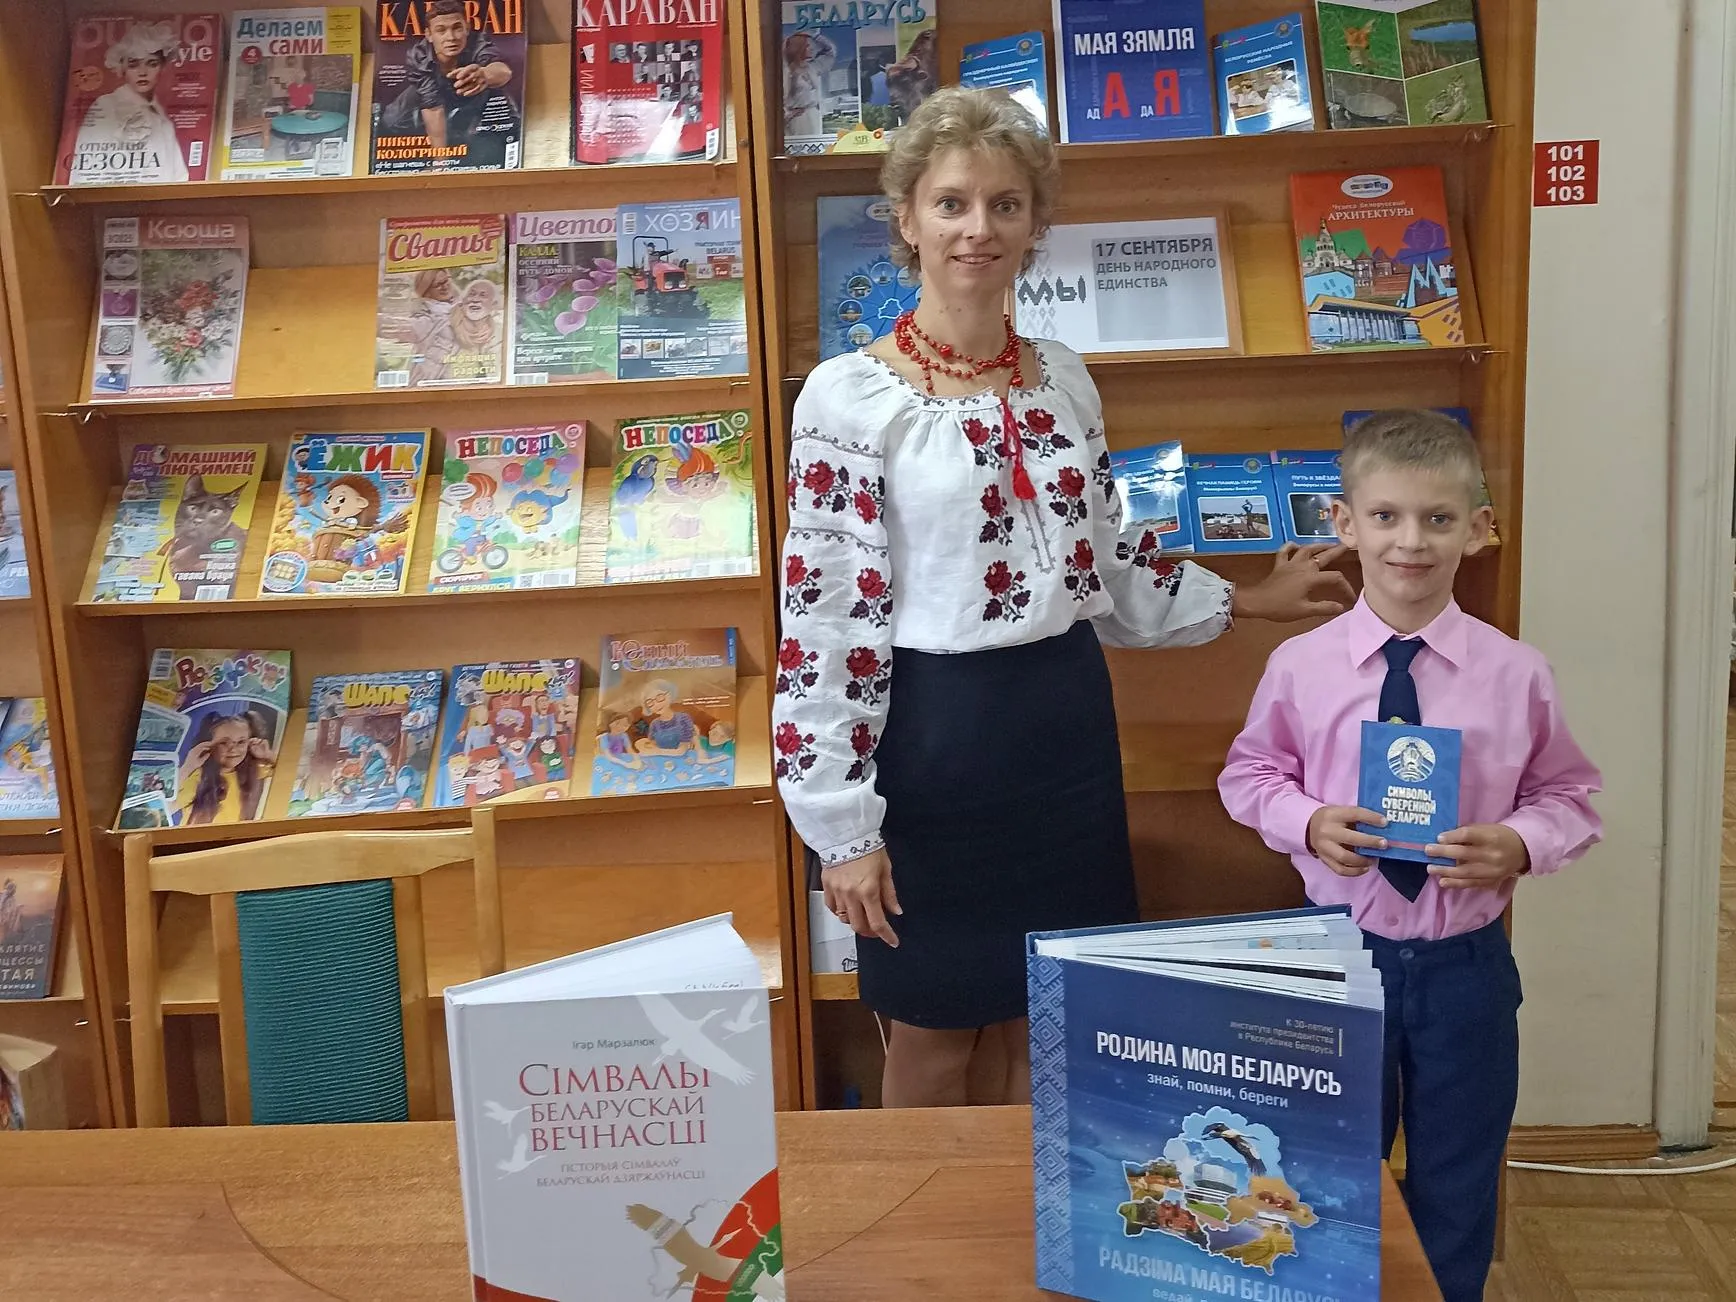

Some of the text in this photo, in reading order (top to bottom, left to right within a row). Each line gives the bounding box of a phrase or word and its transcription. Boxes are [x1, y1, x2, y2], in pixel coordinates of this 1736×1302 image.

[380, 0, 524, 36] КАВАН
[237, 19, 323, 38] Делаем
[269, 38, 323, 55] сами
[1074, 28, 1195, 56] МАЯ ЗЯМЛЯ
[1086, 69, 1181, 120] АД А ДА Я
[63, 151, 161, 171] СЕЗОНА
[376, 144, 467, 160] КОЛОГРИВЫЙ
[1547, 144, 1584, 162] 101
[1547, 165, 1585, 181] 102
[1547, 186, 1585, 202] 103
[1328, 208, 1414, 221] АРХИТЕКТУРЫ
[148, 220, 235, 240] Ксюша
[388, 233, 493, 262] Сваты
[1096, 238, 1213, 258] 17 СЕНТЯБРЯ
[1096, 258, 1216, 275] ДЕНЬ НАРОДНОГО
[1098, 278, 1168, 290] ЕДИНСТВА
[624, 420, 732, 449] НЕПОСЕДА
[457, 432, 565, 458] НЕПОСЕДА
[1388, 786, 1431, 800] СИМВОЛЫ
[572, 1037, 656, 1050] Ігар Марзалюк
[1096, 1031, 1342, 1097] РОДИНА МОЯ БЕЛАРУСЬ
[519, 1062, 712, 1097] СІМВАЛЫ
[1147, 1073, 1289, 1109] знай, помни, береги
[531, 1091, 705, 1124] БЕЛАРУСКАЙ
[536, 1174, 610, 1187] БЕЛАРУСКАЙ
[1100, 1247, 1186, 1286] РАДЗІМА
[1191, 1267, 1236, 1297] МАЯ
